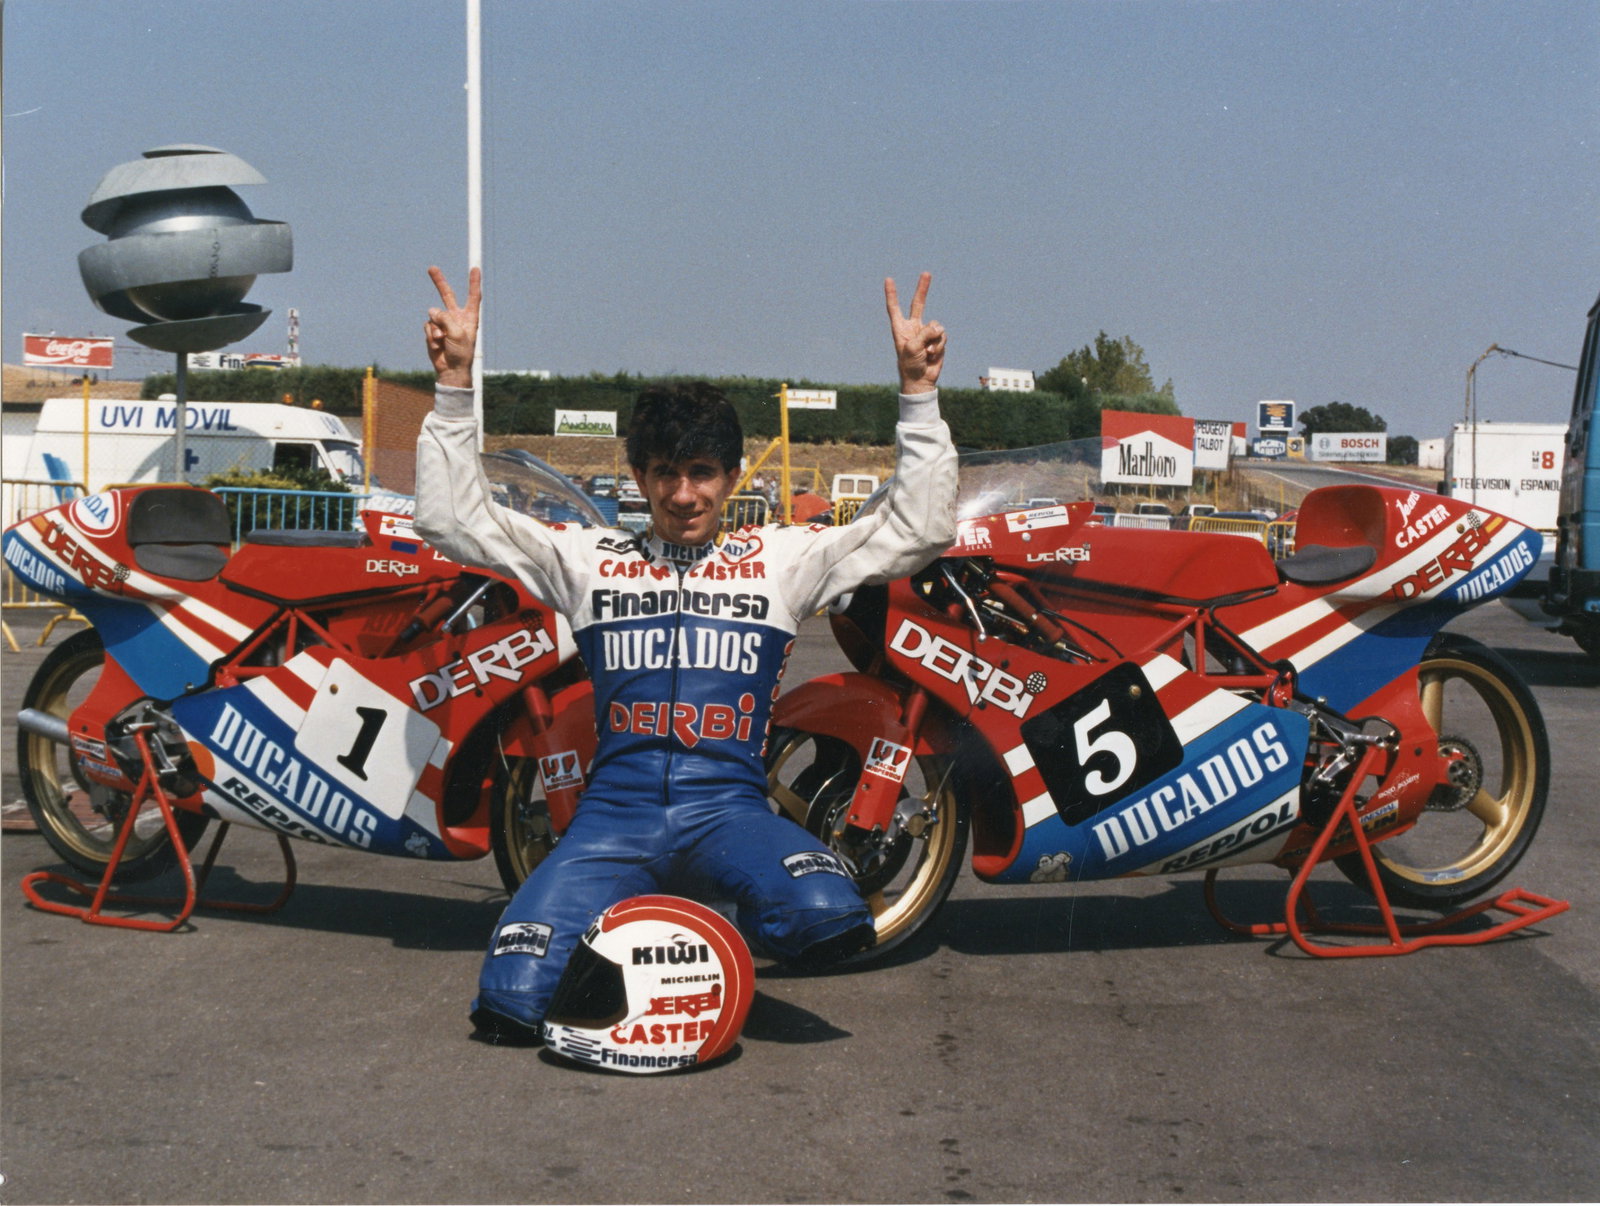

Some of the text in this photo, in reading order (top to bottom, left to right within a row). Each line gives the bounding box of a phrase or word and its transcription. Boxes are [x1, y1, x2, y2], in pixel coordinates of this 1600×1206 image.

[101, 406, 238, 431] UVI MOVIL
[1196, 422, 1229, 436] PEUGEOT
[1118, 441, 1177, 478] Marlboro
[1197, 437, 1224, 451] TALBOT
[1341, 438, 1379, 449] BOSCH
[1541, 451, 1555, 470] 8
[1460, 478, 1511, 490] TELEVISION
[1395, 503, 1451, 549] CASTER
[4, 536, 66, 596] DUCADOS
[1456, 540, 1535, 604] DUCADOS
[592, 588, 770, 620] Finamersa
[602, 626, 762, 675] DUCADOS
[336, 706, 388, 782] 1
[1073, 698, 1137, 796] 5
[209, 701, 378, 849] DUCADOS
[1092, 721, 1290, 862] DUCADOS
[222, 776, 342, 848] REPSO
[1159, 801, 1296, 875] REPSOL
[632, 944, 709, 965] KIWI
[661, 973, 720, 985] MICHELIN
[601, 1048, 699, 1068] Finamersa
